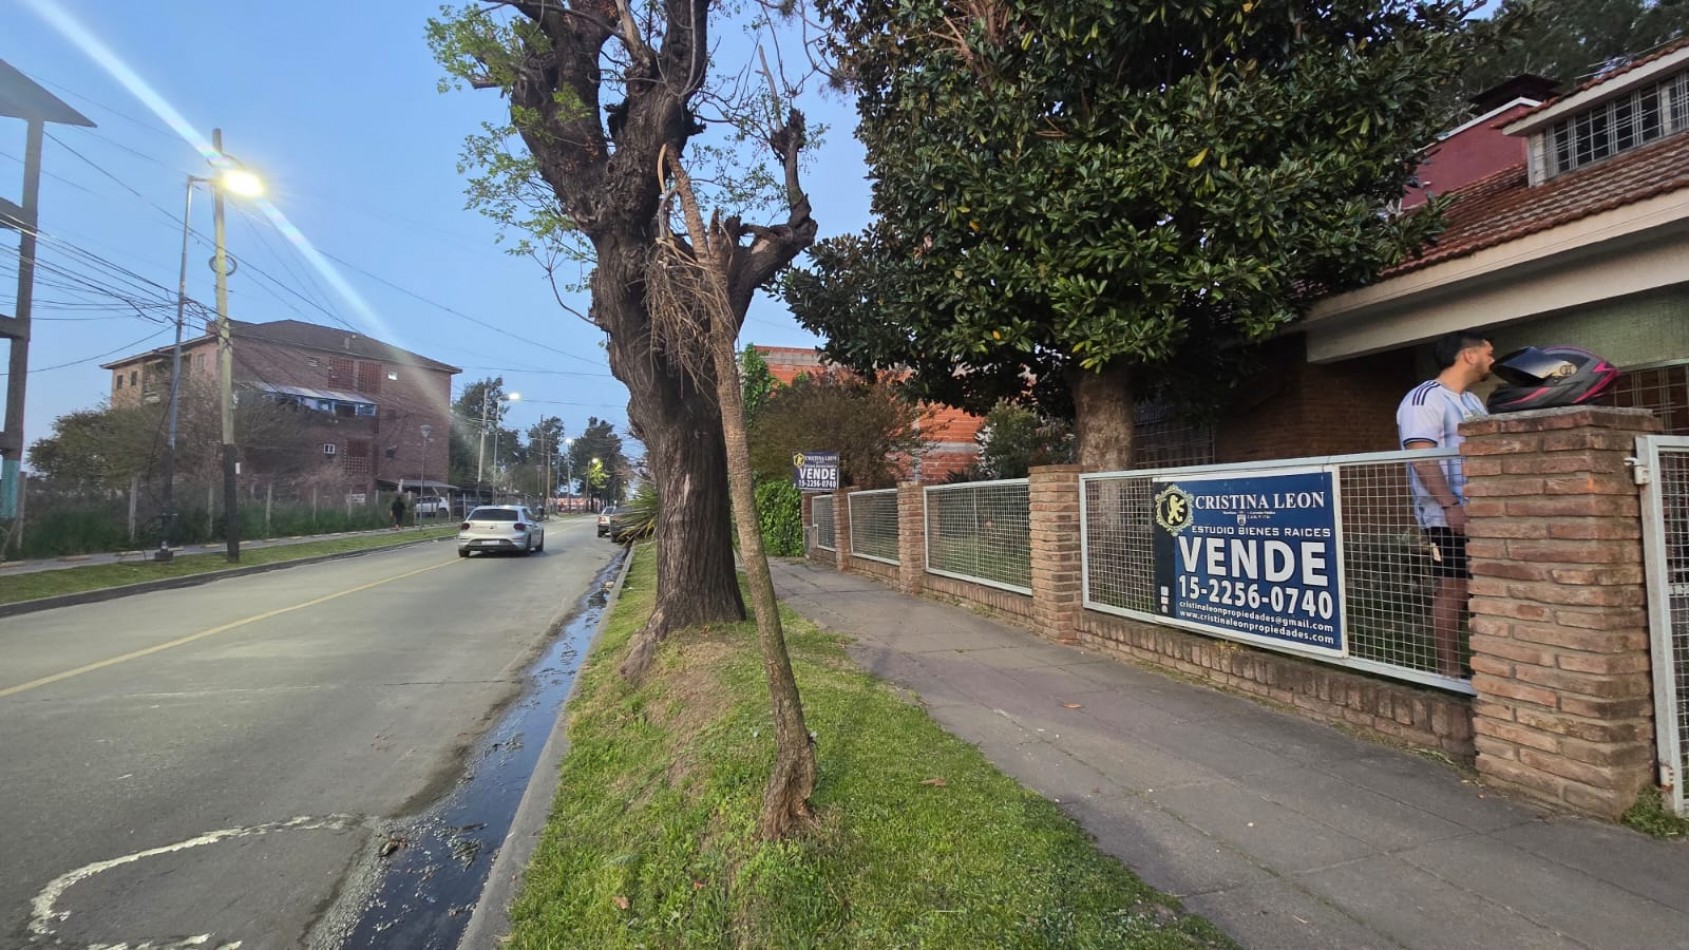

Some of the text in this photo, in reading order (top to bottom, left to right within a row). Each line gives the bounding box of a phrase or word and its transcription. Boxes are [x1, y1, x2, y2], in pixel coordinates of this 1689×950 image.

[800, 468, 836, 480] VENDE
[1195, 491, 1325, 510] CRISTINA LEON
[1191, 525, 1331, 538] ESTUDIO BIENES RAICES
[1178, 536, 1329, 587] VENDE
[1178, 575, 1333, 620] 15-2256-0740
[1179, 601, 1334, 632] cristinaleonpropiedades@gmail.com
[1179, 611, 1334, 644] www.cristinaleonpropiedades.com
